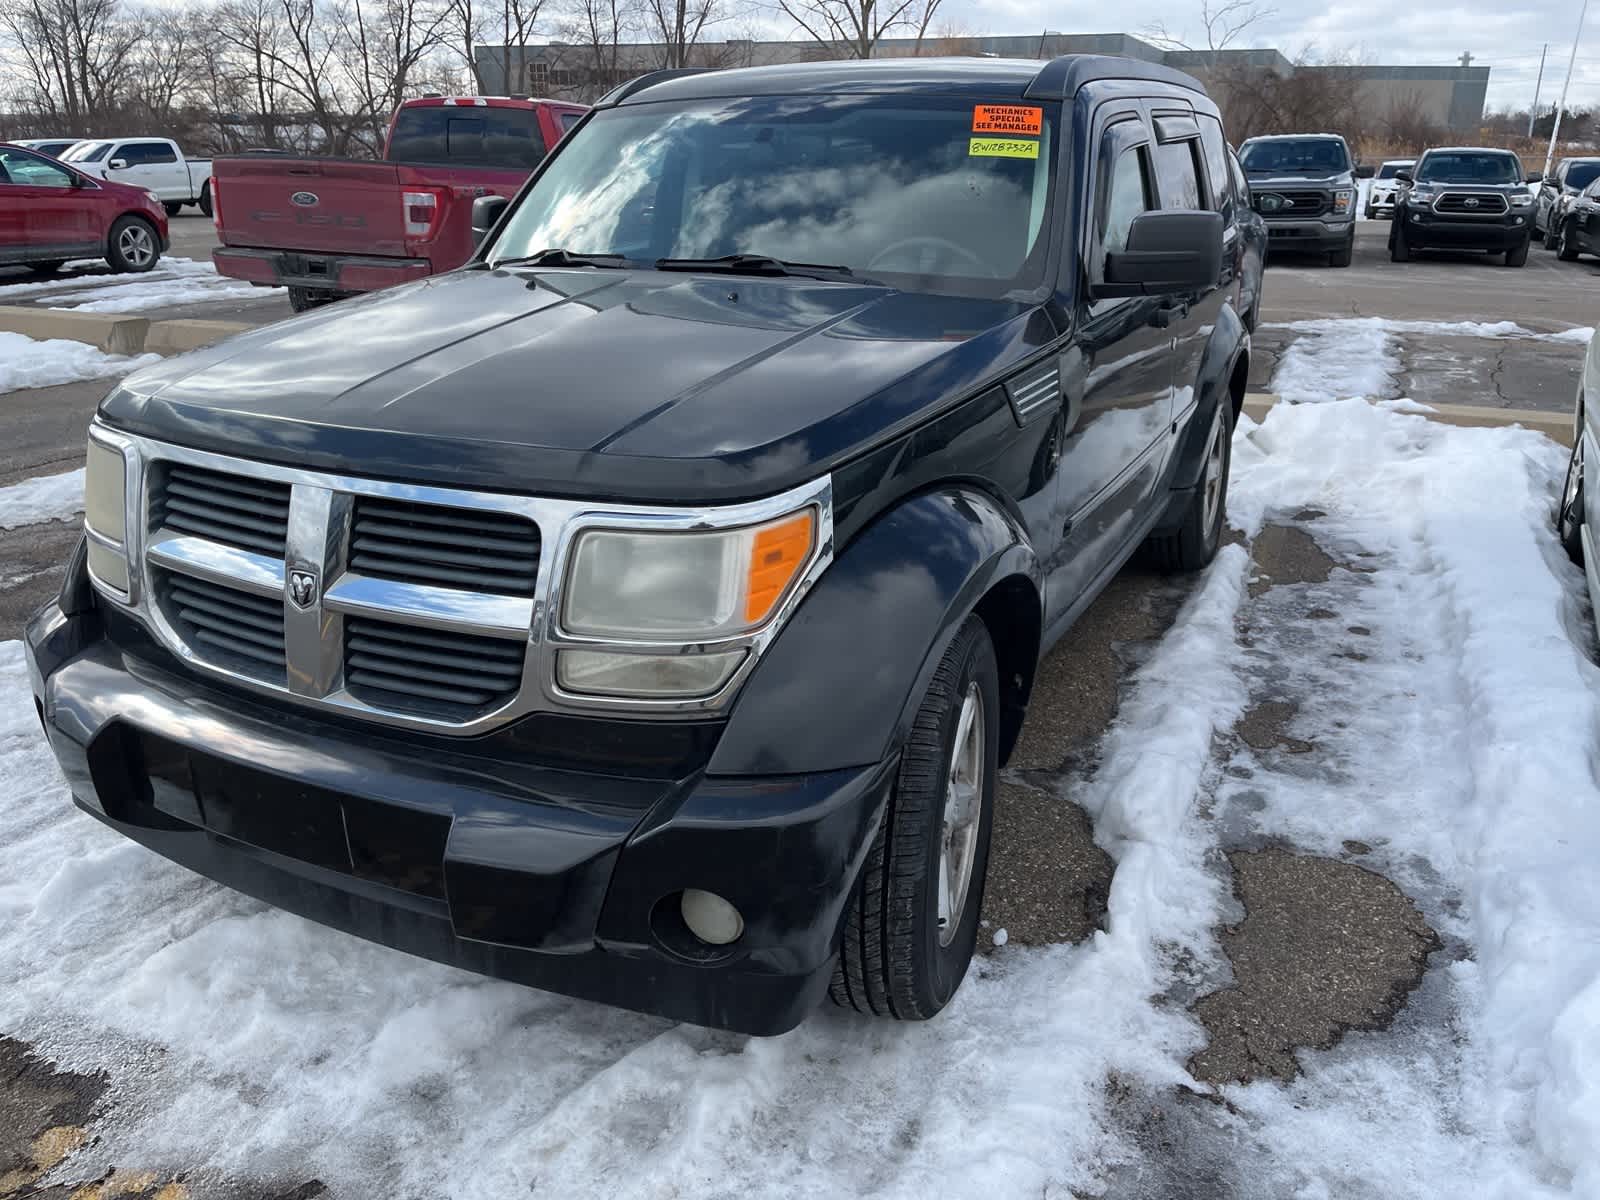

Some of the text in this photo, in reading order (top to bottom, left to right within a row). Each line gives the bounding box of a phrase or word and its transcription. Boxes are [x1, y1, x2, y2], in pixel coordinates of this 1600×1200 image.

[983, 107, 1033, 116] MECHANICS
[989, 115, 1025, 123] SPECIAL
[994, 122, 1038, 131] MANAGER
